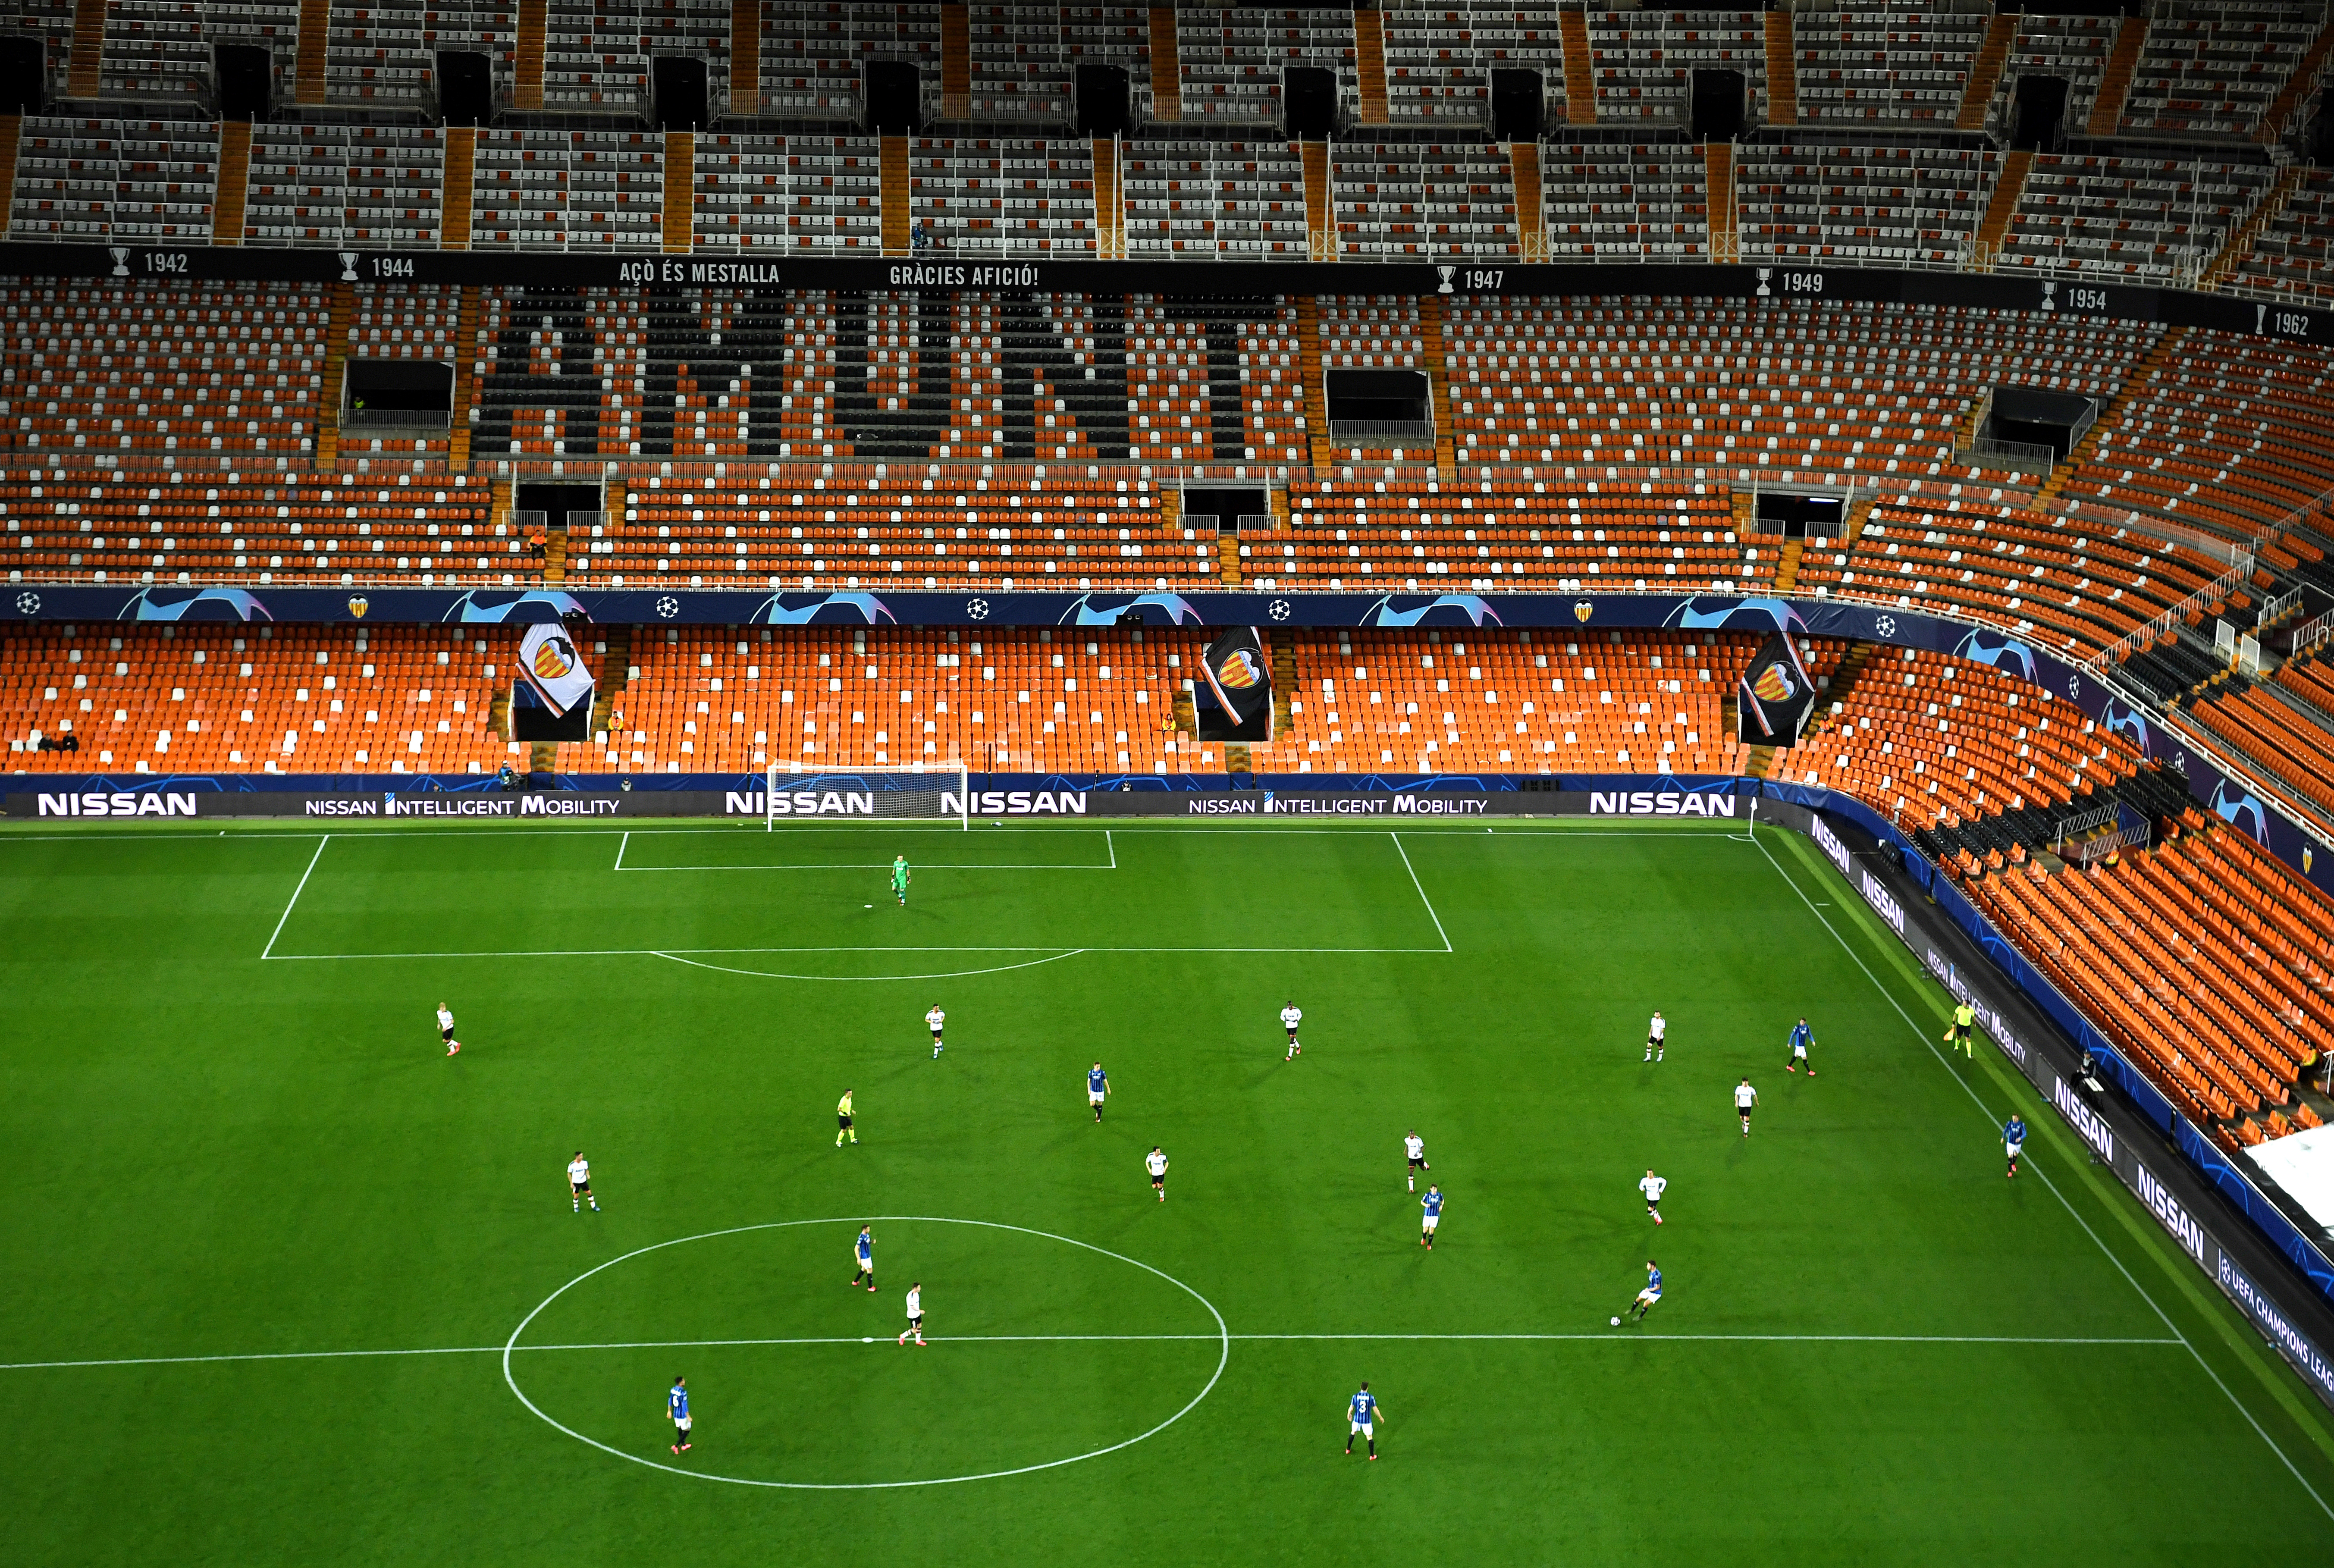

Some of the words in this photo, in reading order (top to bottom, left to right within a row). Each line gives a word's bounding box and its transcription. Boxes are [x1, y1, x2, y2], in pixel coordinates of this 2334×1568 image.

[145, 253, 187, 272] 1942
[373, 258, 414, 277] 1944
[619, 259, 654, 286] AÇÒ
[662, 259, 684, 282] ÉS
[692, 263, 779, 283] MESTALLA
[890, 262, 965, 285] GRÀCIES
[972, 263, 1038, 285] AFICIÓ!
[1465, 270, 1504, 289] 1947
[1783, 273, 1823, 292] 1949
[2069, 289, 2106, 310] 1954
[2276, 312, 2309, 336] 1962
[38, 793, 196, 816] NISSAN
[306, 800, 376, 815] NISSAN
[385, 792, 514, 815] INTELLIGENT
[521, 795, 620, 814] MOBILITY
[726, 792, 873, 814] NISSAN
[941, 792, 1086, 813] NISSAN
[1189, 800, 1255, 813] NISSAN
[1264, 791, 1387, 813] INTELLIGENT
[1393, 795, 1488, 813] MOBILITY
[1590, 792, 1735, 817] NISSAN
[1812, 813, 1850, 874] NISSAN
[1863, 869, 1904, 934] NISSAN
[1928, 948, 1948, 983] NISSAN
[1991, 1011, 2026, 1065] MOBILITY
[2055, 1075, 2112, 1162] NISSAN
[2138, 1163, 2204, 1261] NISSAN
[2232, 1269, 2255, 1308] UEFA
[2256, 1296, 2308, 1364] CHAMPIONS
[2311, 1351, 2334, 1394] LEAG
[673, 1396, 679, 1407] 6
[1359, 1401, 1366, 1413] 3
